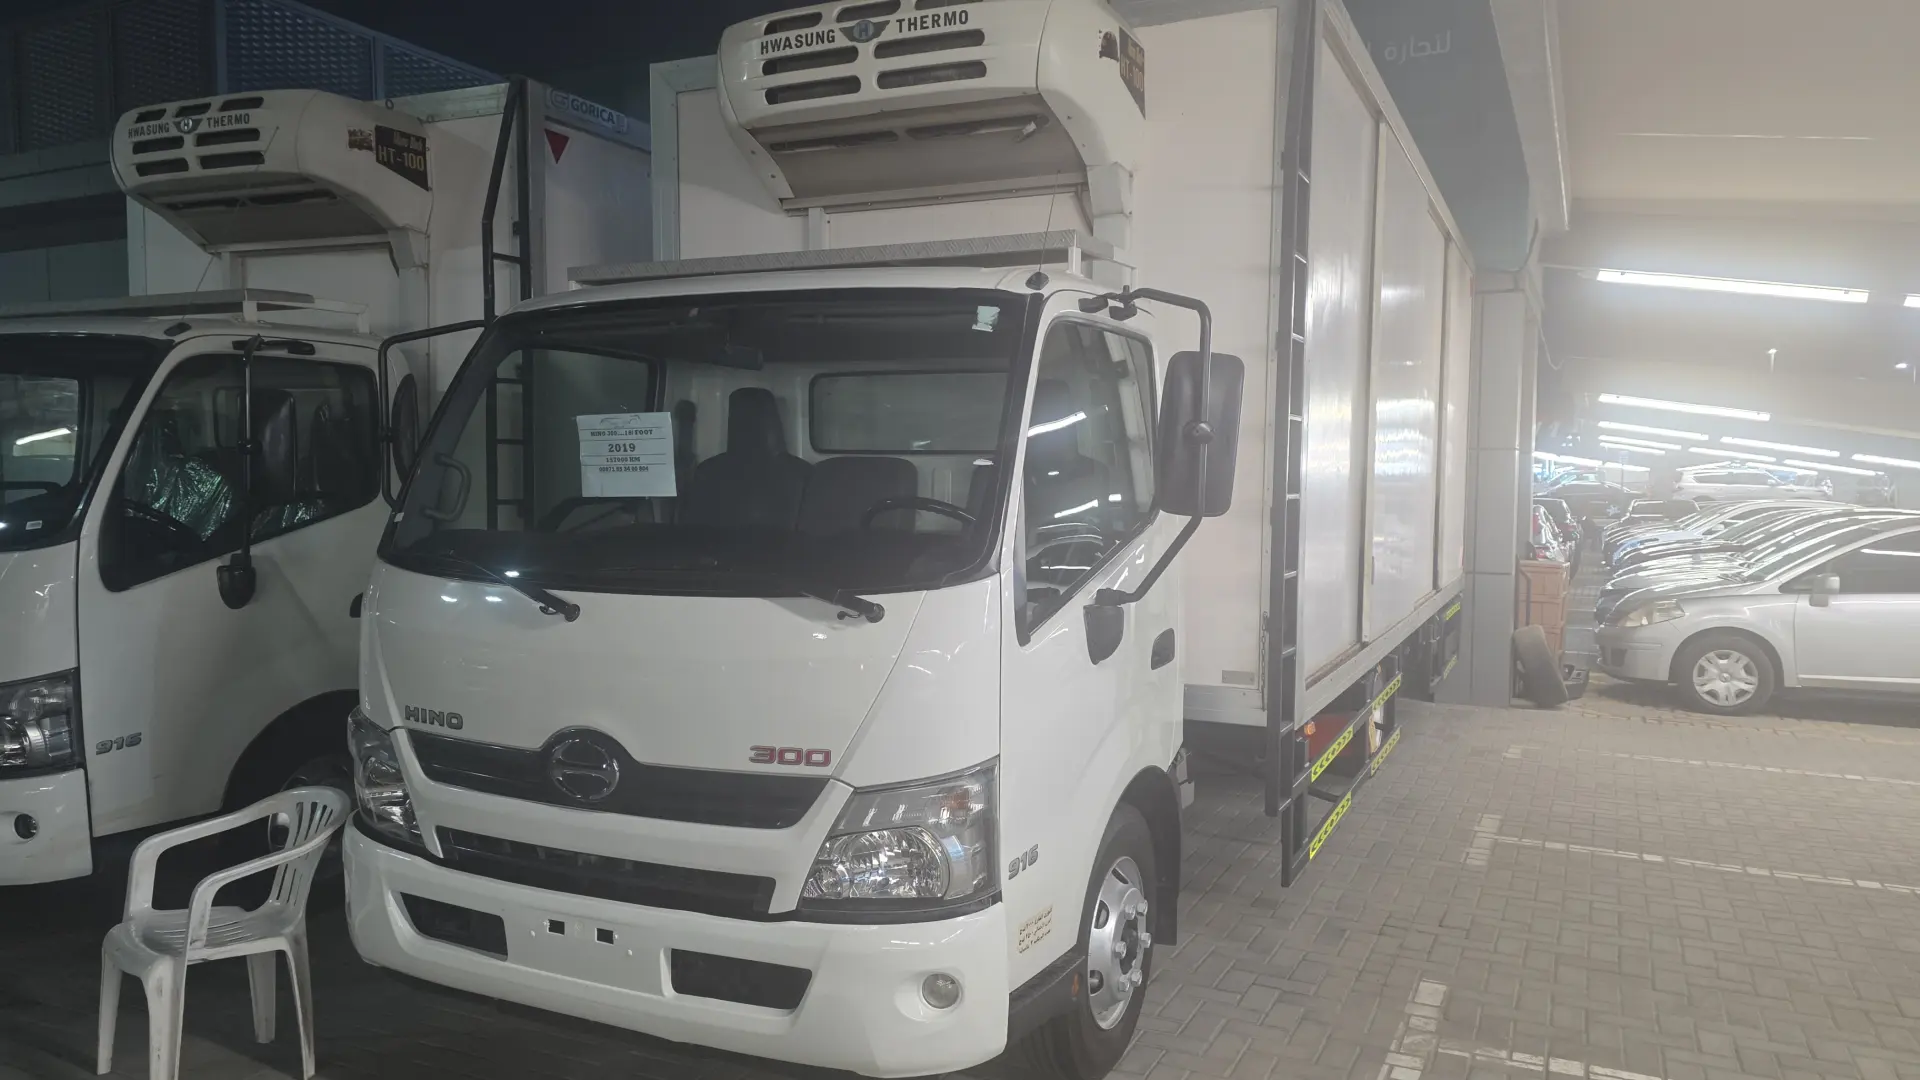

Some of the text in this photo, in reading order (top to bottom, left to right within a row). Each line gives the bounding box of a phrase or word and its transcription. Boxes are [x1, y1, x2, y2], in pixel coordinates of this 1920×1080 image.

[760, 29, 836, 55] HWASUNG
[896, 9, 969, 34] THERMO
[570, 98, 616, 125] GORICA
[128, 121, 170, 139] HWASUNG
[206, 113, 250, 129] THERMO
[377, 144, 425, 172] HT-100
[608, 442, 636, 453] 2019
[404, 704, 464, 730] HINO
[95, 731, 142, 756] 916
[748, 744, 832, 767] 300
[1008, 843, 1039, 881] 916
